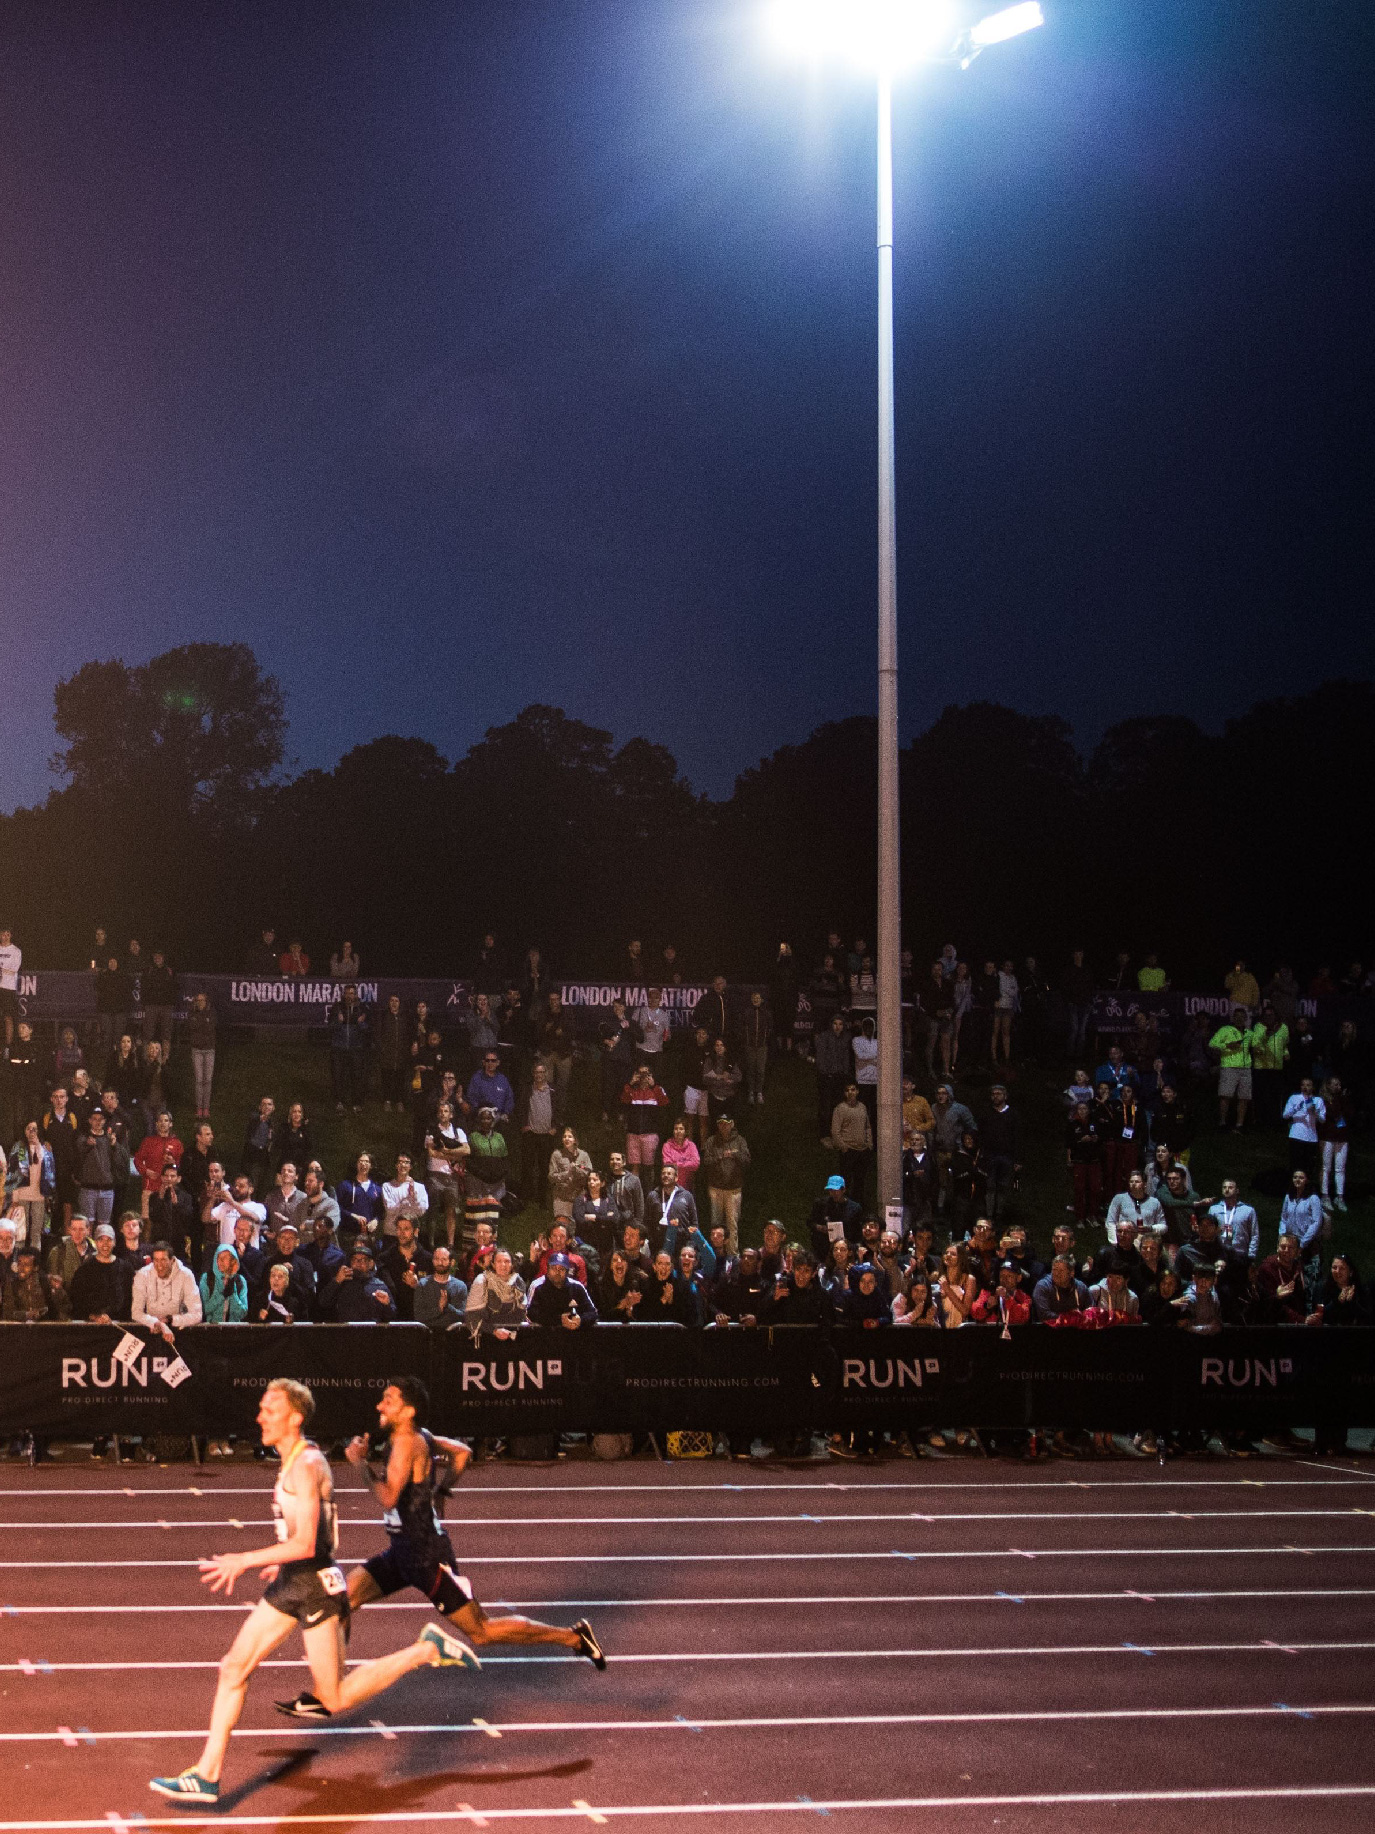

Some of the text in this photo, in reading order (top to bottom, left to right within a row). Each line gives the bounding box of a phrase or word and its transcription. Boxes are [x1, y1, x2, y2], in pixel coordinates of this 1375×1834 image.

[231, 982, 294, 1003] LONDON
[62, 1358, 147, 1388] RUN
[462, 1360, 543, 1391] RUN
[843, 1359, 922, 1388] RUN
[1201, 1358, 1277, 1387] RUN
